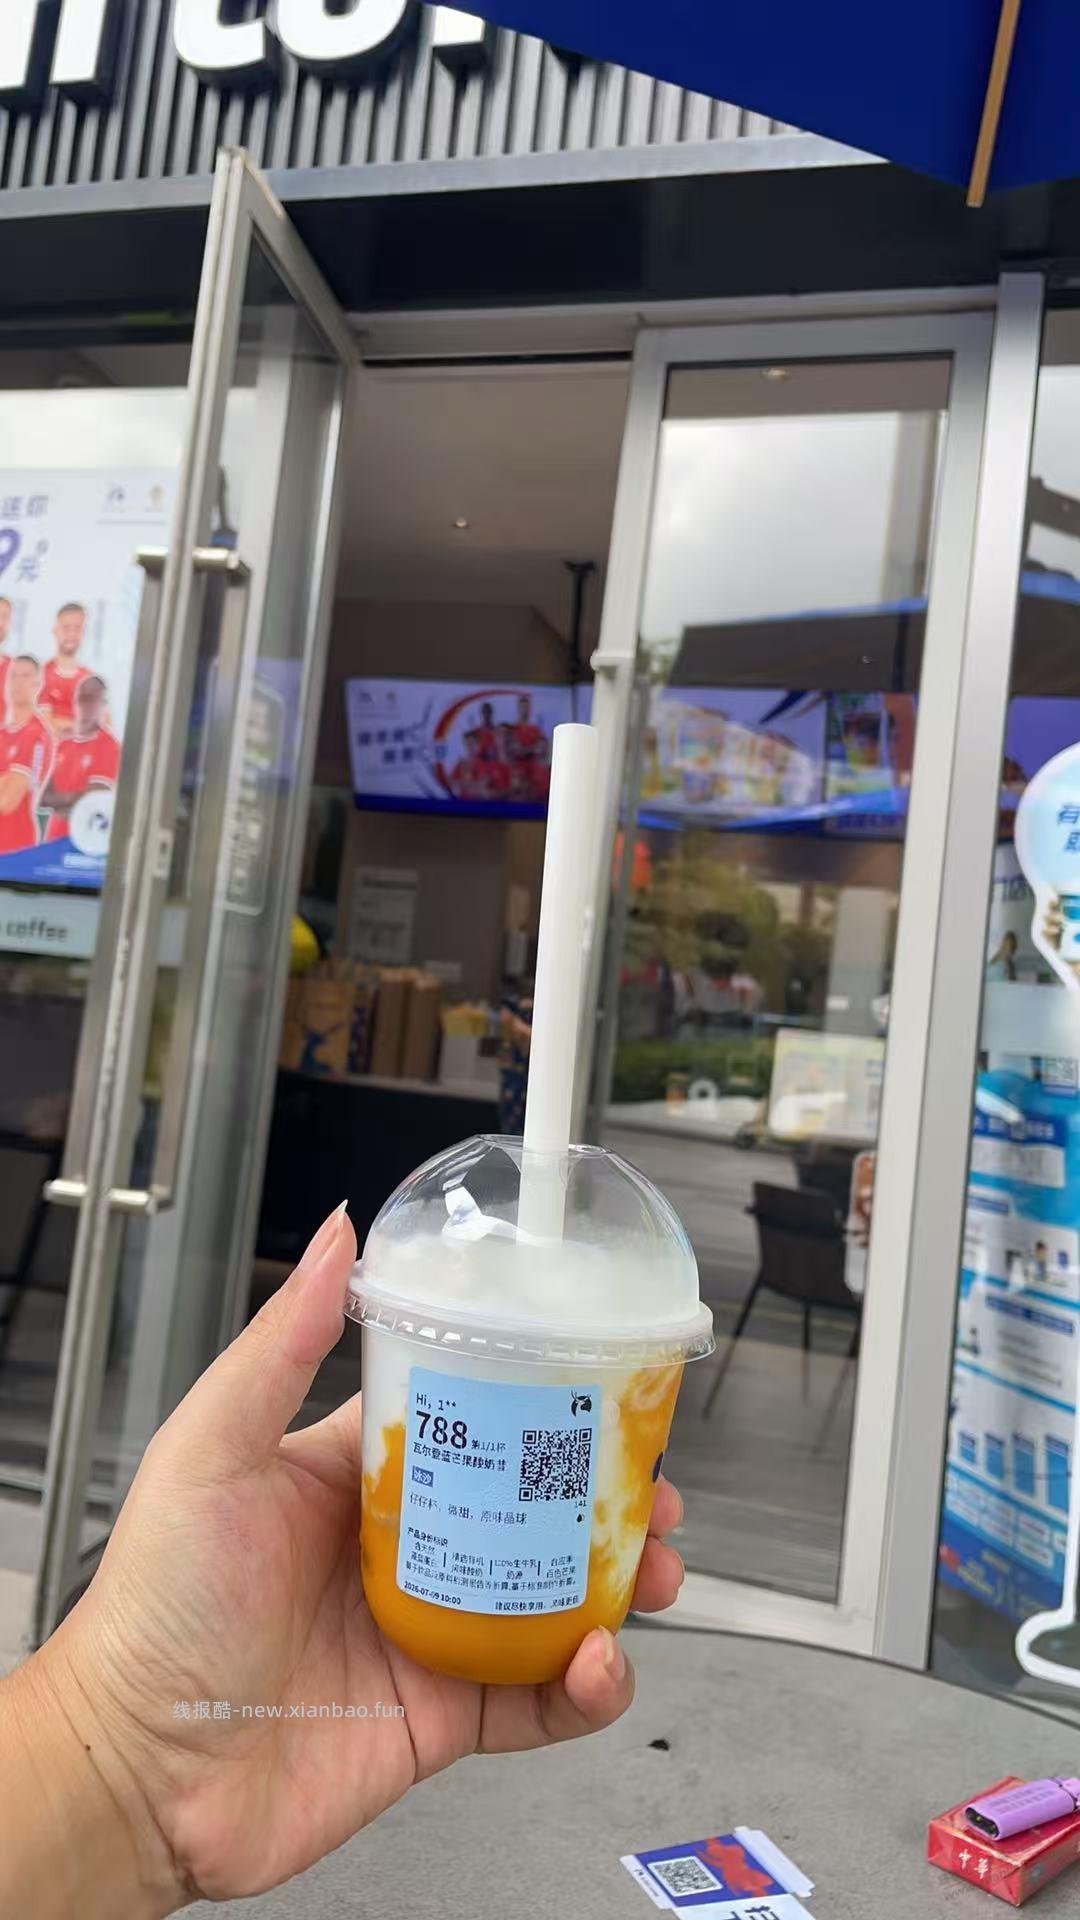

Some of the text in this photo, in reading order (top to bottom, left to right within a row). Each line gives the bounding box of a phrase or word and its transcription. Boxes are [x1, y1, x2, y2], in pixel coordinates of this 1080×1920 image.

[7, 915, 68, 943] coffee
[416, 1410, 468, 1449] 788
[413, 1442, 507, 1472] 瓦尔登蓝芒果酸奶昔
